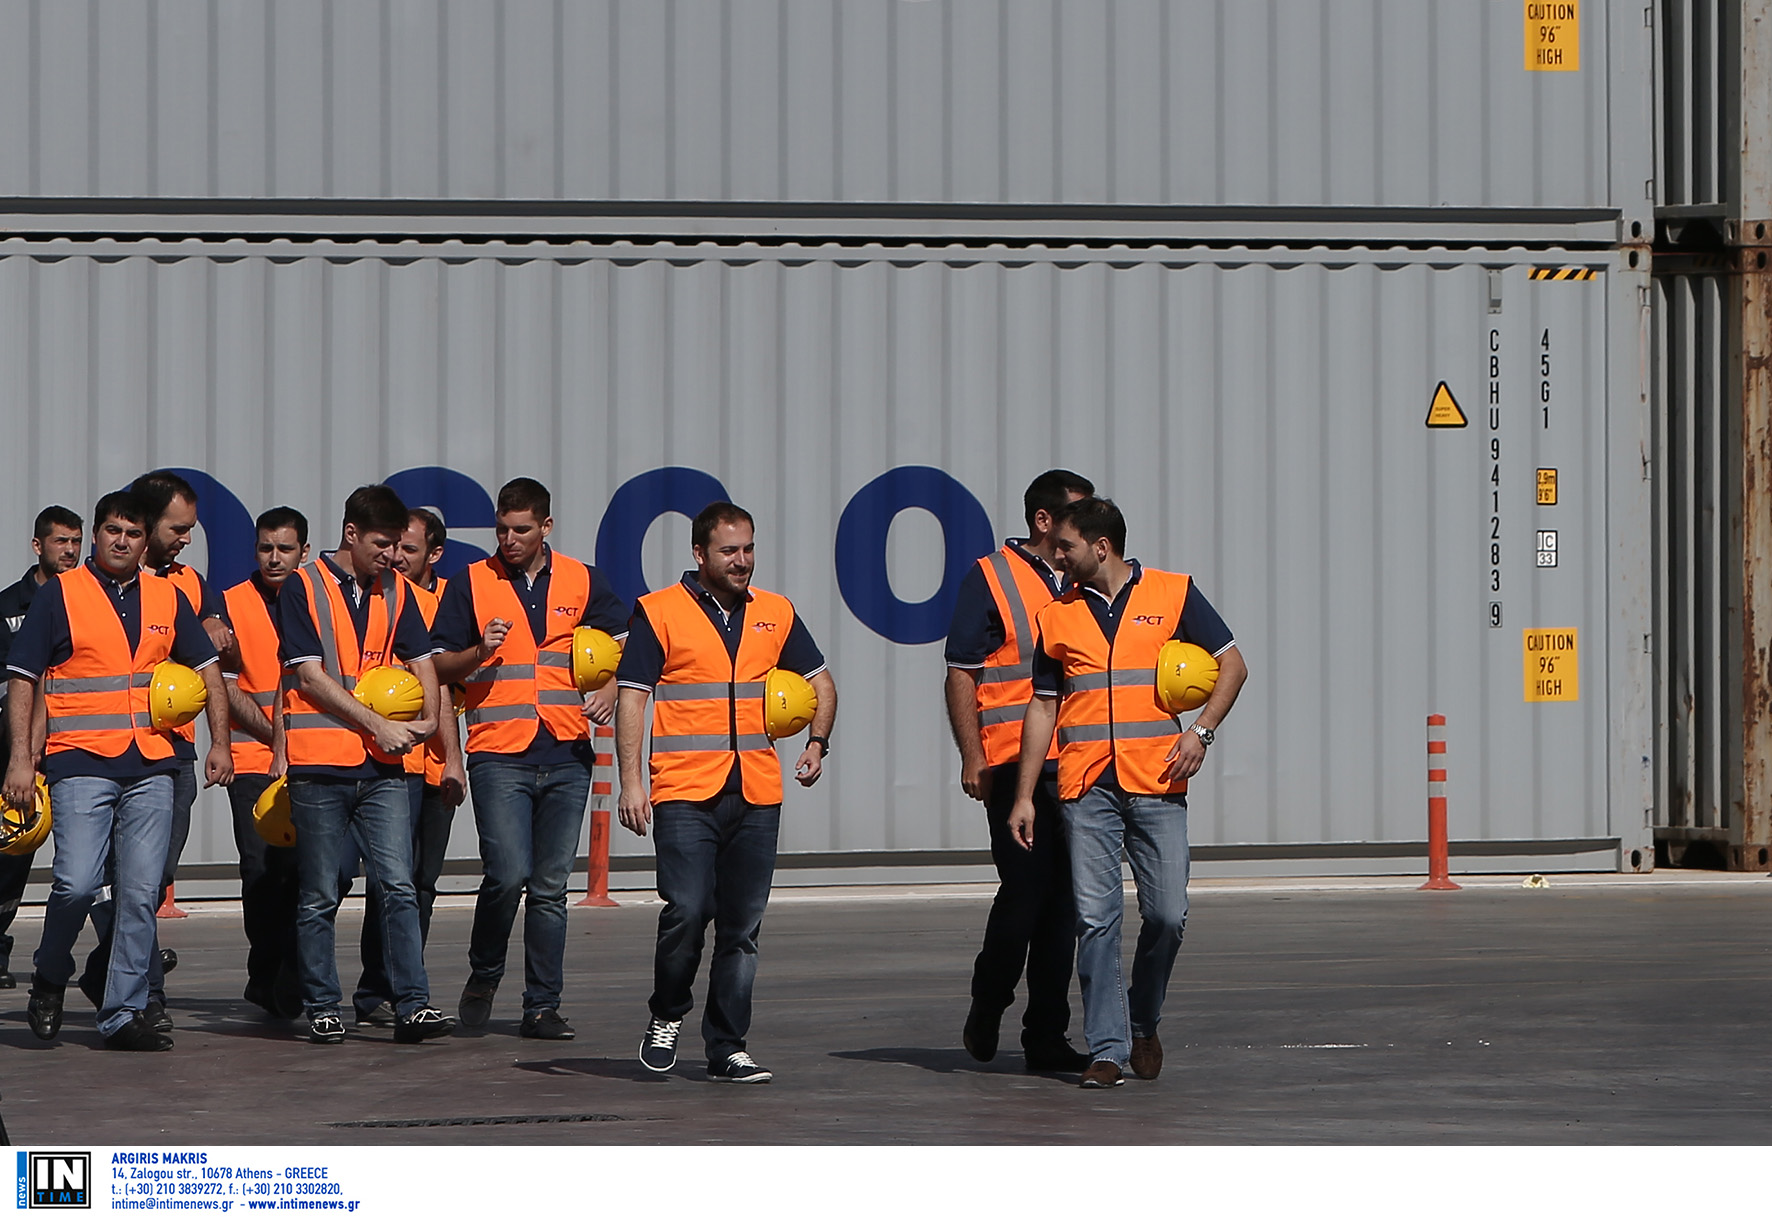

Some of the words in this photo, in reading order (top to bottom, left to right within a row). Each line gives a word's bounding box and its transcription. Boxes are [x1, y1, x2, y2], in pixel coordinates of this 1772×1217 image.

[1528, 3, 1574, 21] CAUTION
[1536, 48, 1562, 65] HIGH
[1489, 329, 1500, 431] CBHU
[1541, 328, 1550, 429] 45G1
[1491, 437, 1500, 592] 941283
[1539, 553, 1553, 564] 33
[1491, 603, 1500, 627] 9
[1527, 634, 1573, 651] CAUTION
[1536, 679, 1562, 696] HIGH
